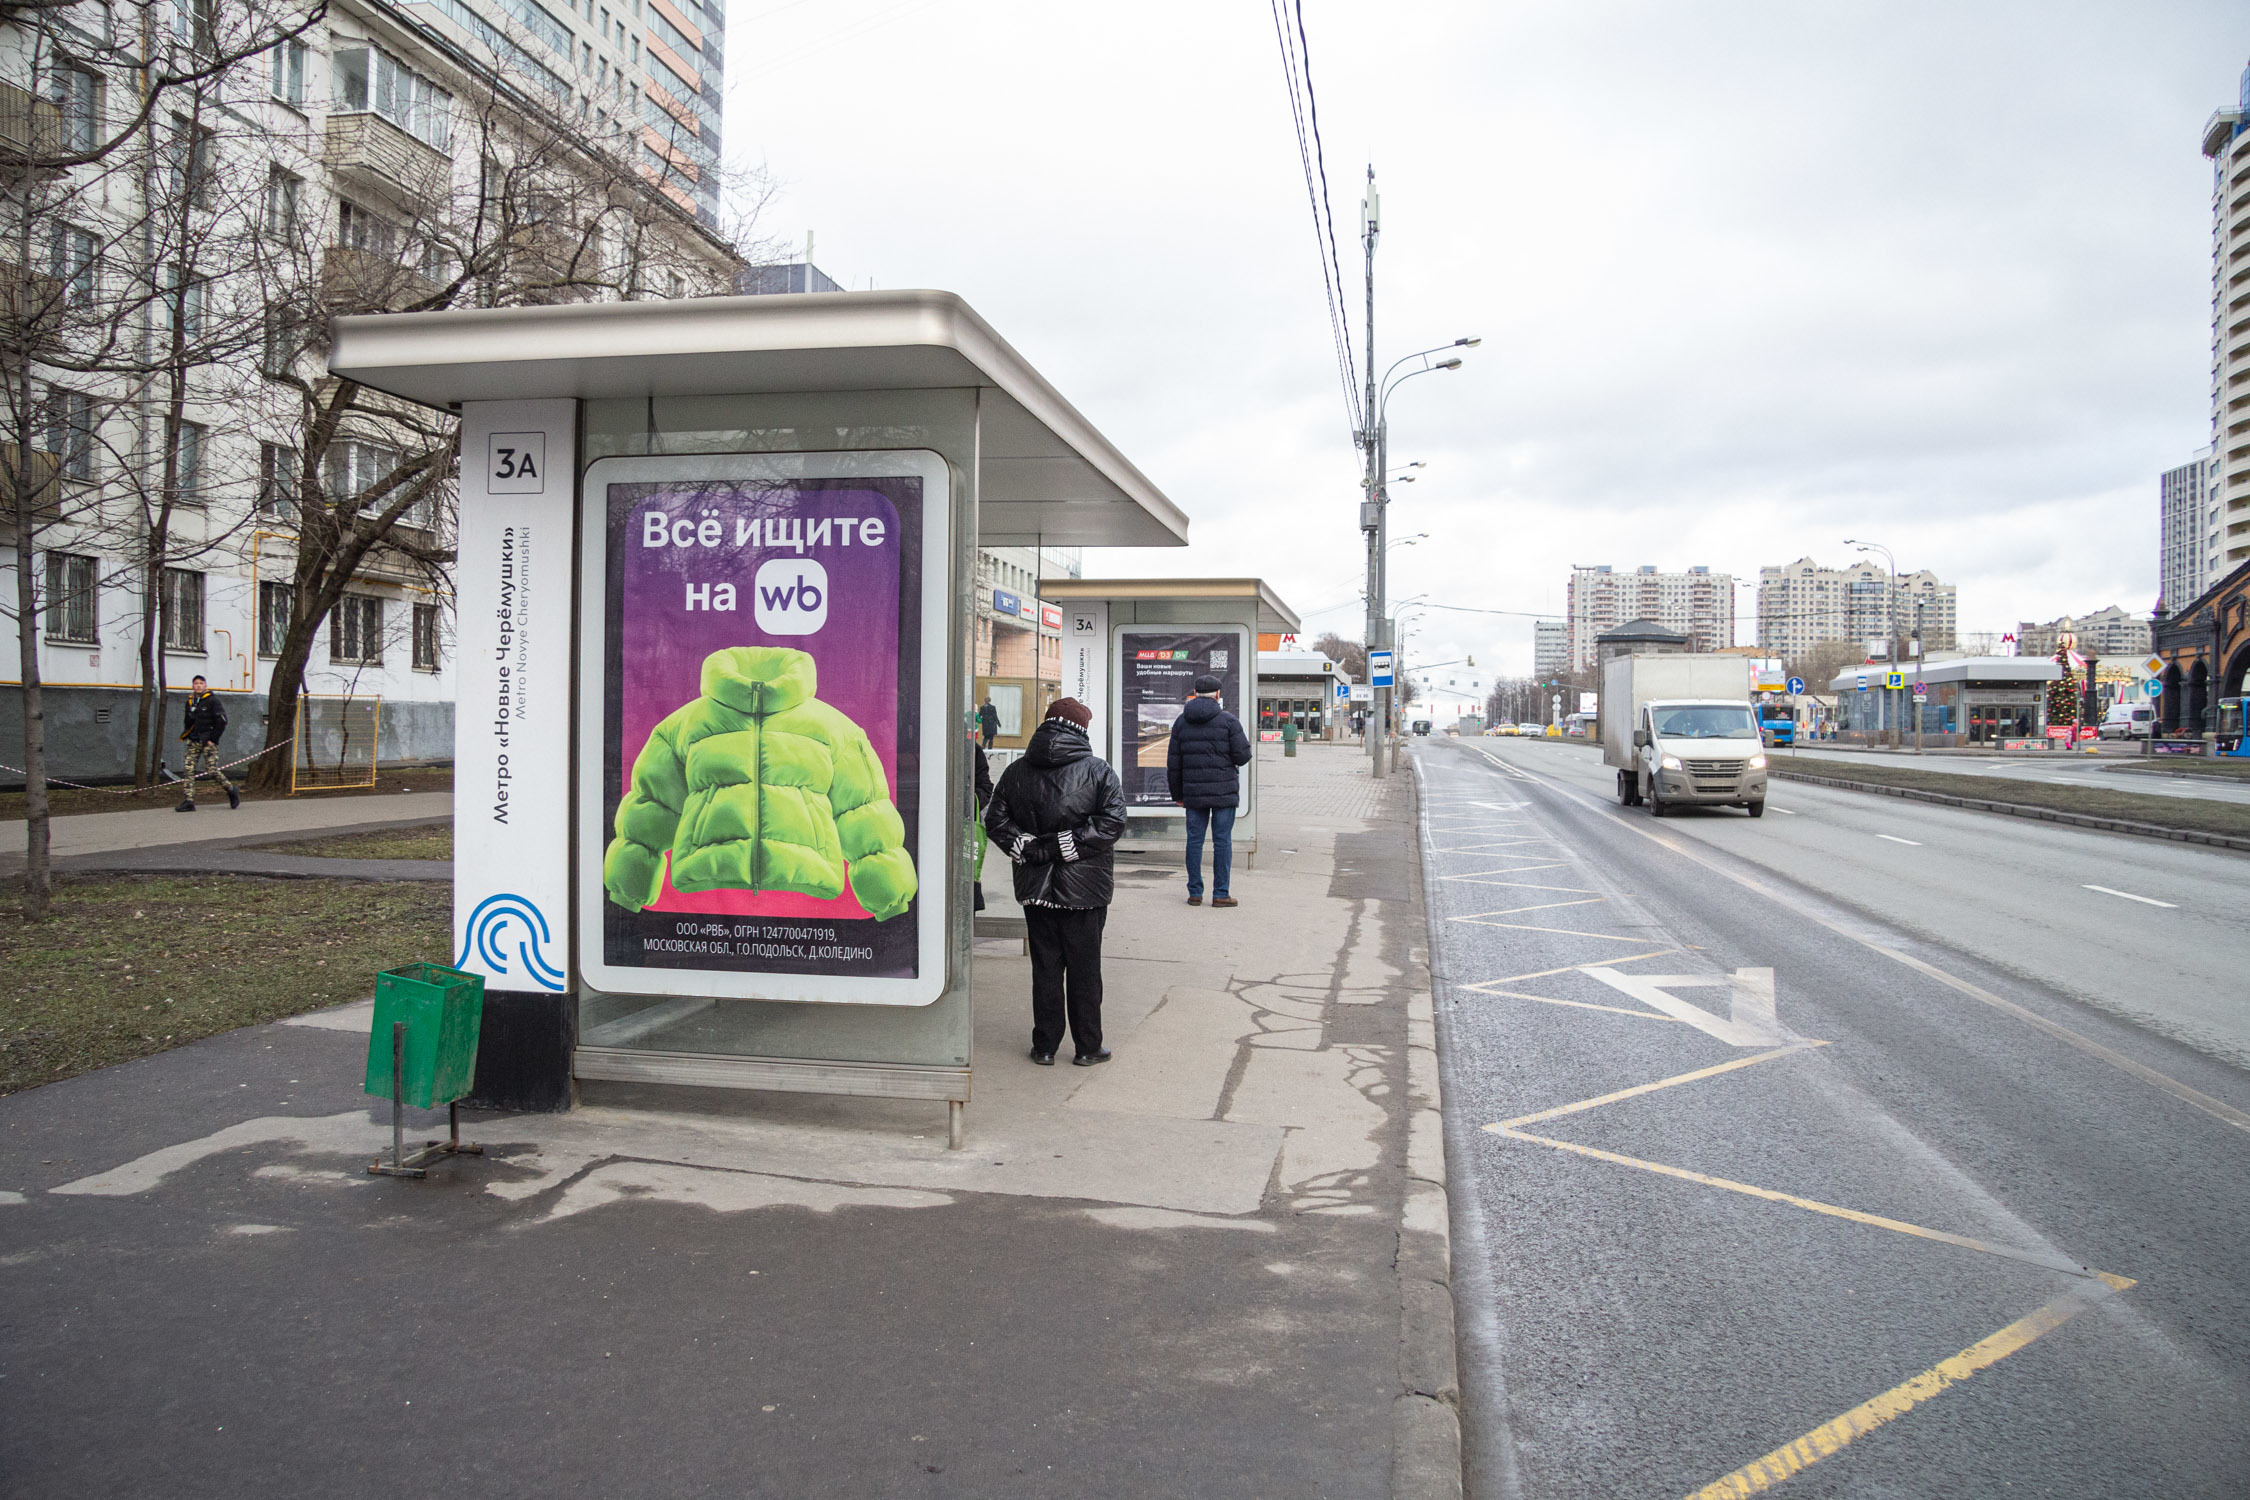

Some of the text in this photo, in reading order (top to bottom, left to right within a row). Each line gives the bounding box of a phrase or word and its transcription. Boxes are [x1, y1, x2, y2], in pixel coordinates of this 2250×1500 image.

[495, 448, 538, 479] 3А
[643, 509, 886, 554] Всё ищите
[685, 582, 737, 612] на
[760, 574, 823, 612] wb
[515, 527, 531, 720] Metro Novye Cheryomushki
[1075, 619, 1094, 631] 3А
[493, 527, 516, 825] Метро «Новые Черёмушки»
[676, 922, 837, 942] ООО «РВБ», ОГРН 1247700471919,
[643, 938, 873, 961] МОСКОВСКАЯ ОБЛ., Г.О.ПОДОЛЬСК, Д.КОЛЕДИНО
